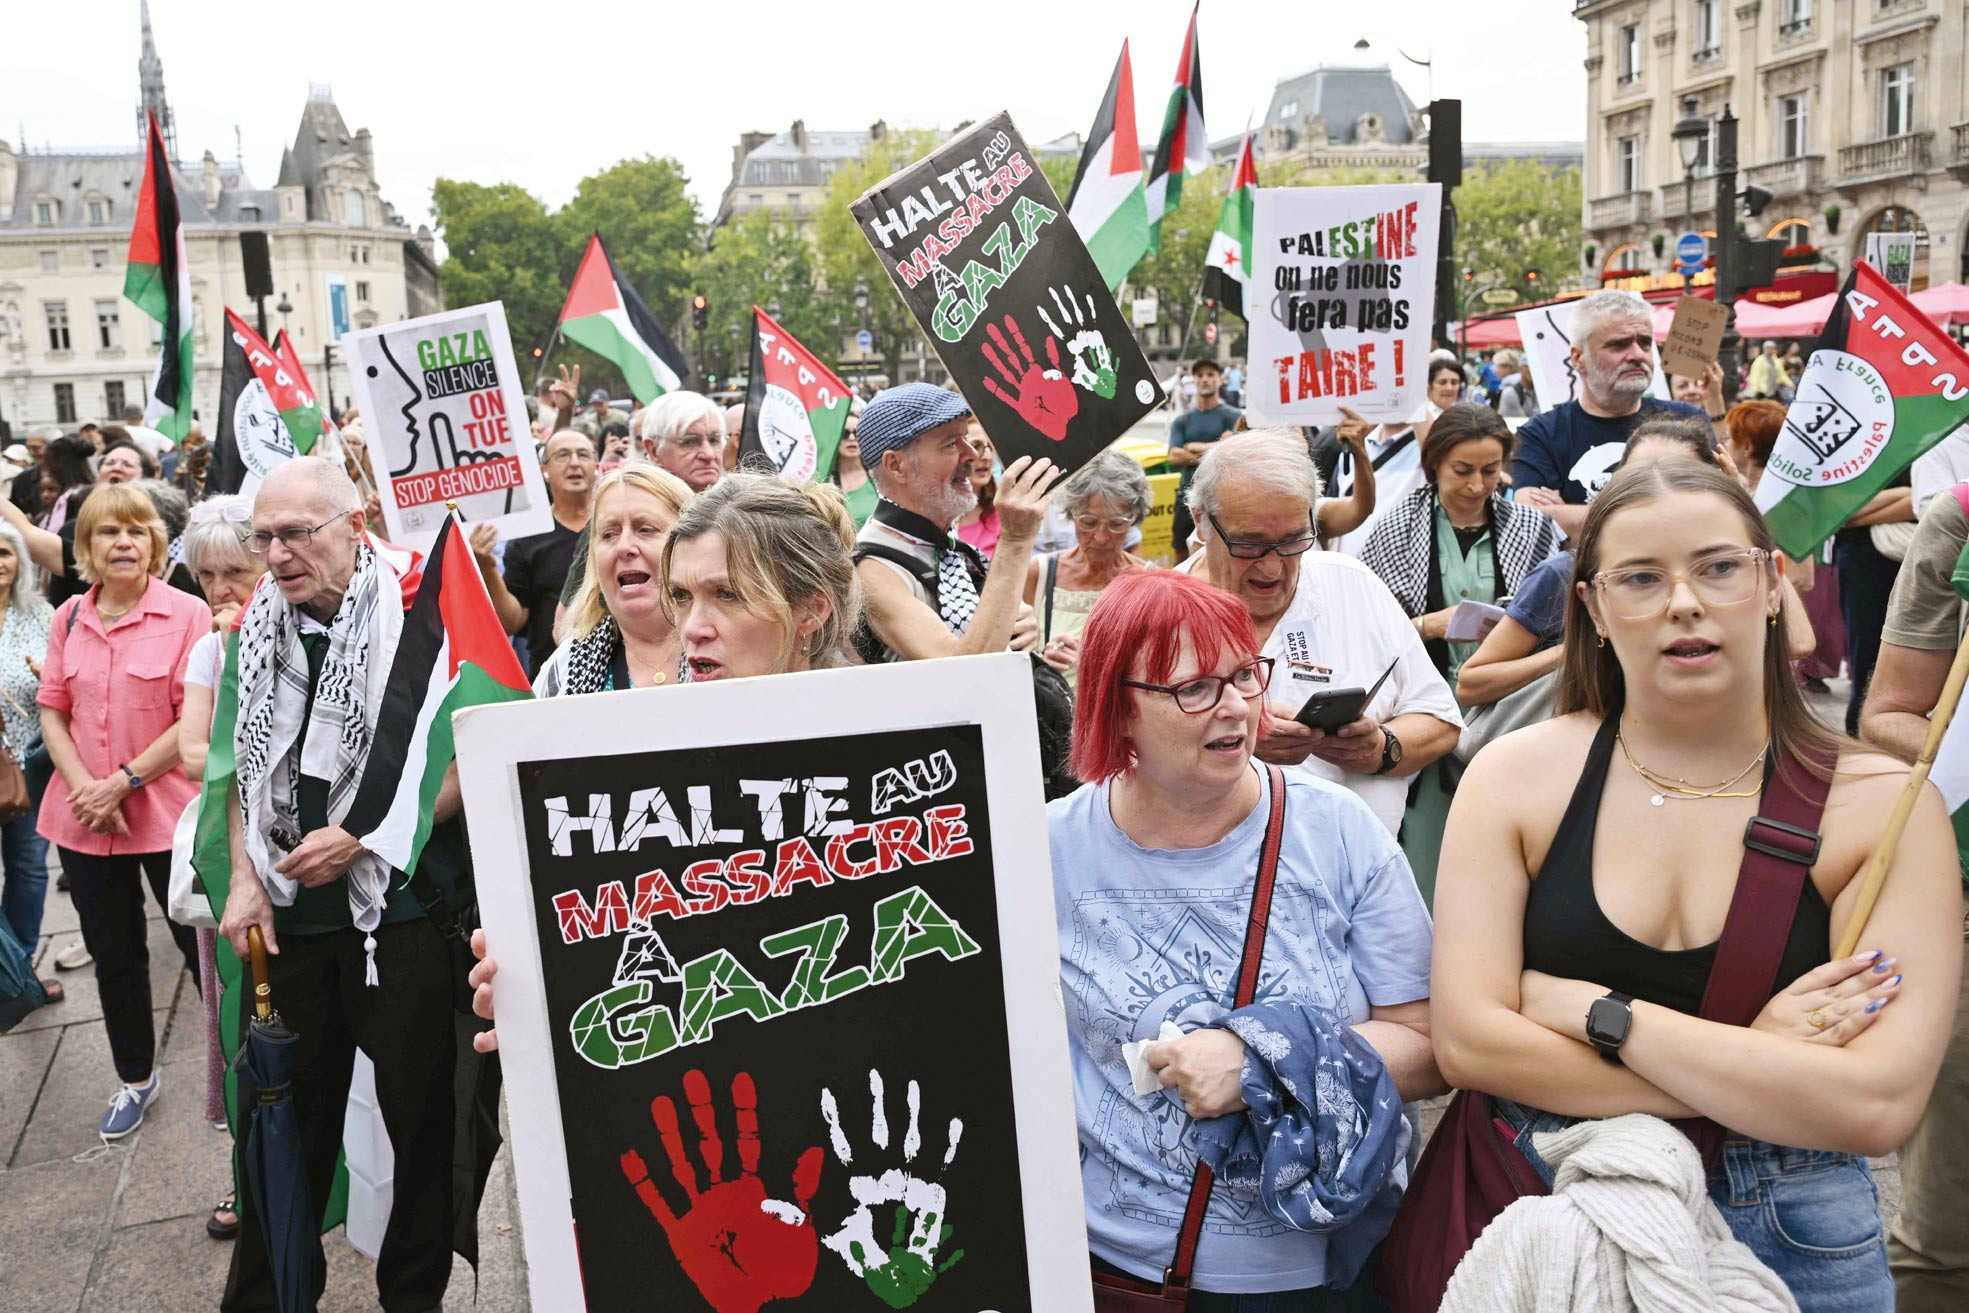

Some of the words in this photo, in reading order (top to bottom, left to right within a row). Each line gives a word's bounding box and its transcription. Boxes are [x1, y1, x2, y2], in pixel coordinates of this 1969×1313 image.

[870, 158, 989, 249] HALTE
[983, 130, 1011, 172] AU
[896, 152, 1033, 289] MASSACRE
[1279, 201, 1418, 260] PALESTINE
[931, 196, 1059, 343] GAZA
[1275, 265, 1301, 291] on
[1310, 264, 1338, 292] ne
[1346, 263, 1402, 291] nous
[1287, 295, 1347, 333] fera
[1358, 298, 1410, 334] pas
[416, 329, 493, 371] GAZA
[426, 359, 497, 398] SILENCE
[1272, 342, 1377, 405] TAIRE
[1393, 339, 1405, 387] !
[469, 389, 505, 420] ON
[463, 417, 512, 449] TUE
[396, 476, 436, 507] STOP
[438, 460, 521, 499] GÉNOCIDE
[1286, 632, 1298, 652] GAZA
[1291, 652, 1300, 661] ET
[1296, 631, 1307, 650] STOP
[1301, 650, 1309, 660] AU
[544, 776, 854, 857] HALTE
[871, 749, 957, 815] AU
[552, 804, 975, 945] MASSACRE
[569, 885, 982, 1070] GAZA
